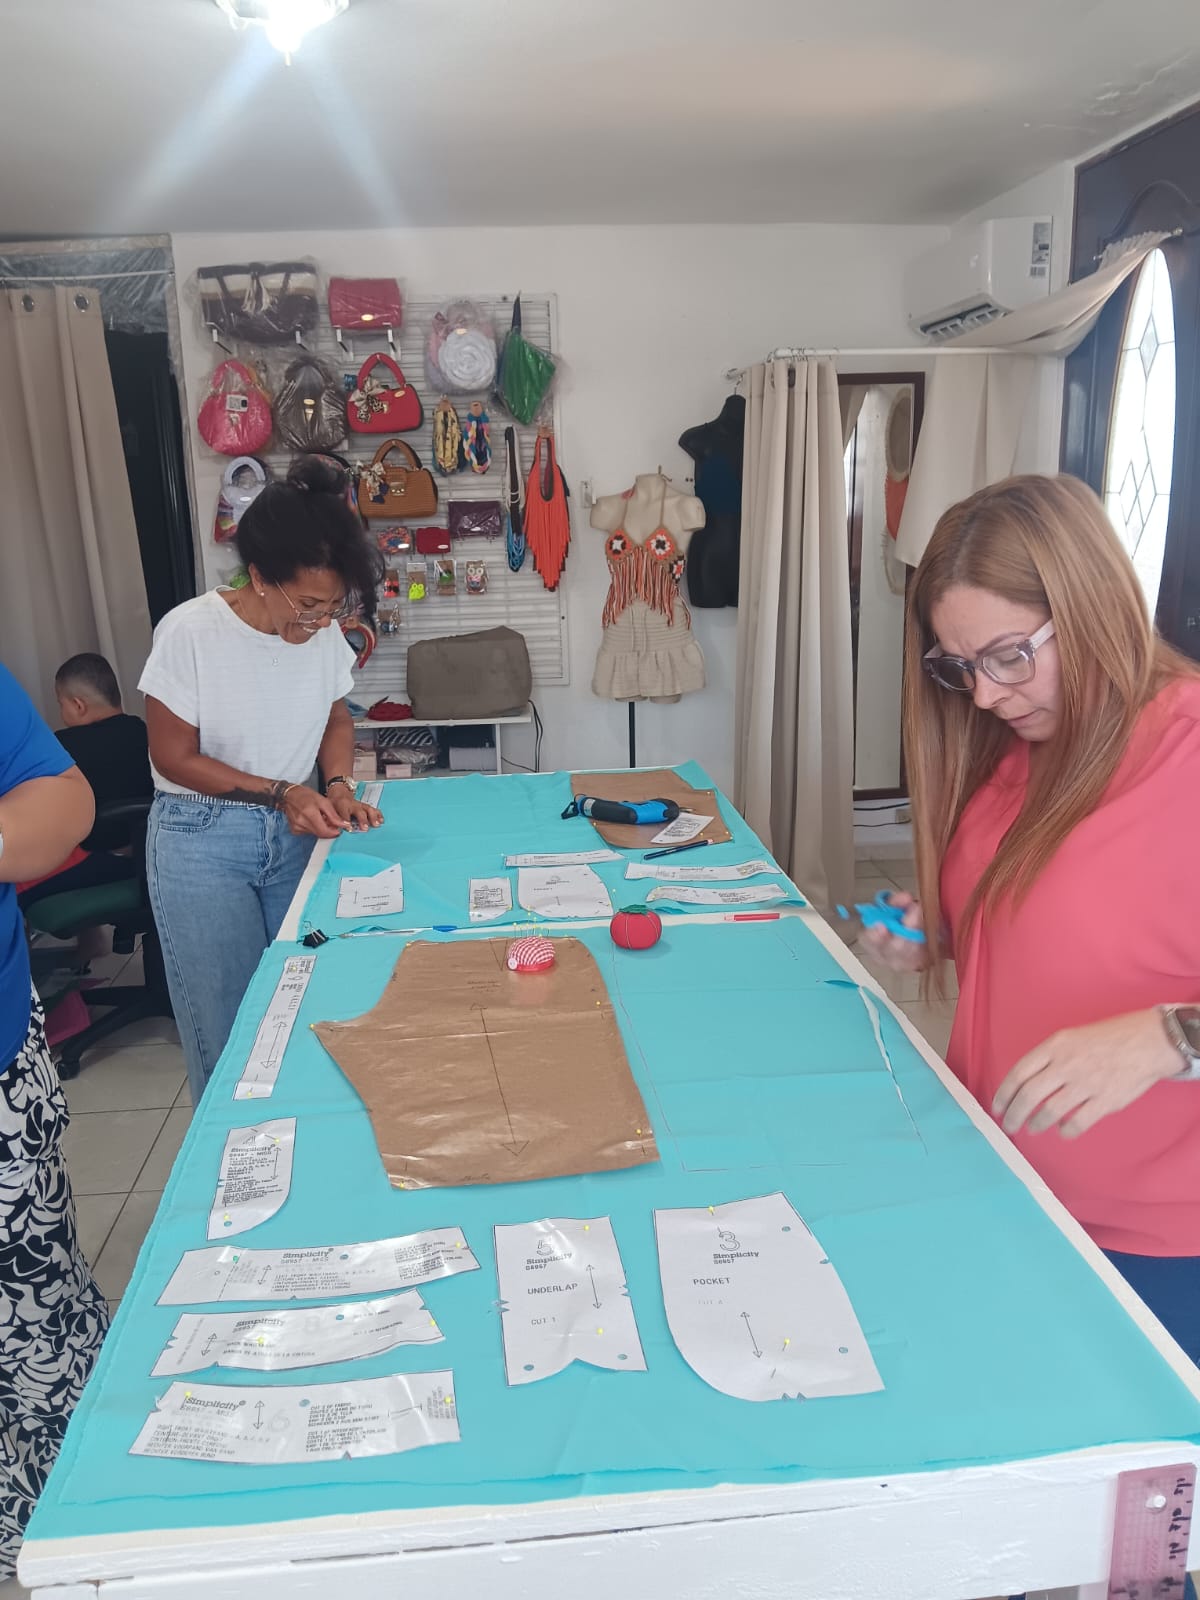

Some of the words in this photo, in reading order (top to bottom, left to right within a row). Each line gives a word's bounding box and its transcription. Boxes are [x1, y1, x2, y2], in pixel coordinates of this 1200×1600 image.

[536, 1239, 555, 1256] 5
[718, 1230, 741, 1252] 3
[281, 1250, 329, 1260] Simplicity
[526, 1251, 573, 1265] Simplicity
[713, 1251, 760, 1259] Simplicity
[692, 1277, 731, 1286] POCKET
[527, 1282, 578, 1295] UNDERLAP
[530, 1317, 546, 1326] CUT
[186, 1396, 240, 1412] Simplicity
